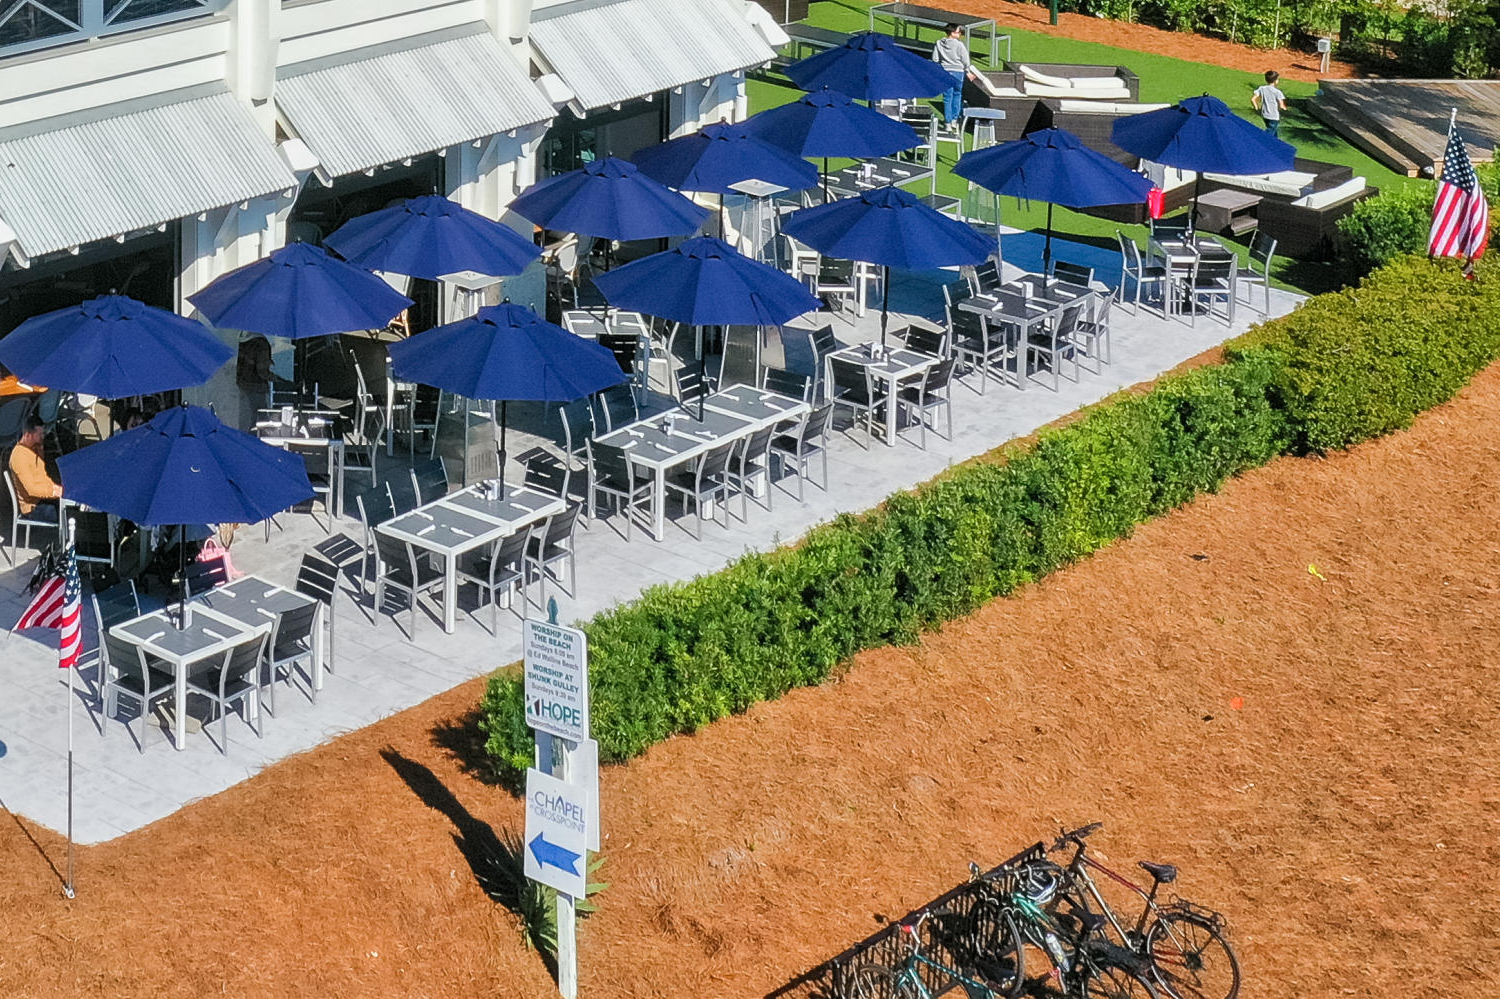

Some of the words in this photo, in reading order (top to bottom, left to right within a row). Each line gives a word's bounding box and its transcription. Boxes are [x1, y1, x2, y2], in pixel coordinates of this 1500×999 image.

[531, 624, 561, 638] WORSHIP
[563, 633, 573, 642] ON
[534, 633, 547, 643] THE
[548, 638, 571, 650] BEACH
[533, 664, 563, 678] WORSHIP
[565, 673, 574, 682] AT
[562, 659, 579, 670] Beach
[528, 672, 551, 684] SHUNK
[553, 680, 579, 693] GULLEY
[542, 698, 581, 727] HOPE
[534, 791, 585, 824] CHAPEL
[534, 806, 586, 833] CROSSPOINT
